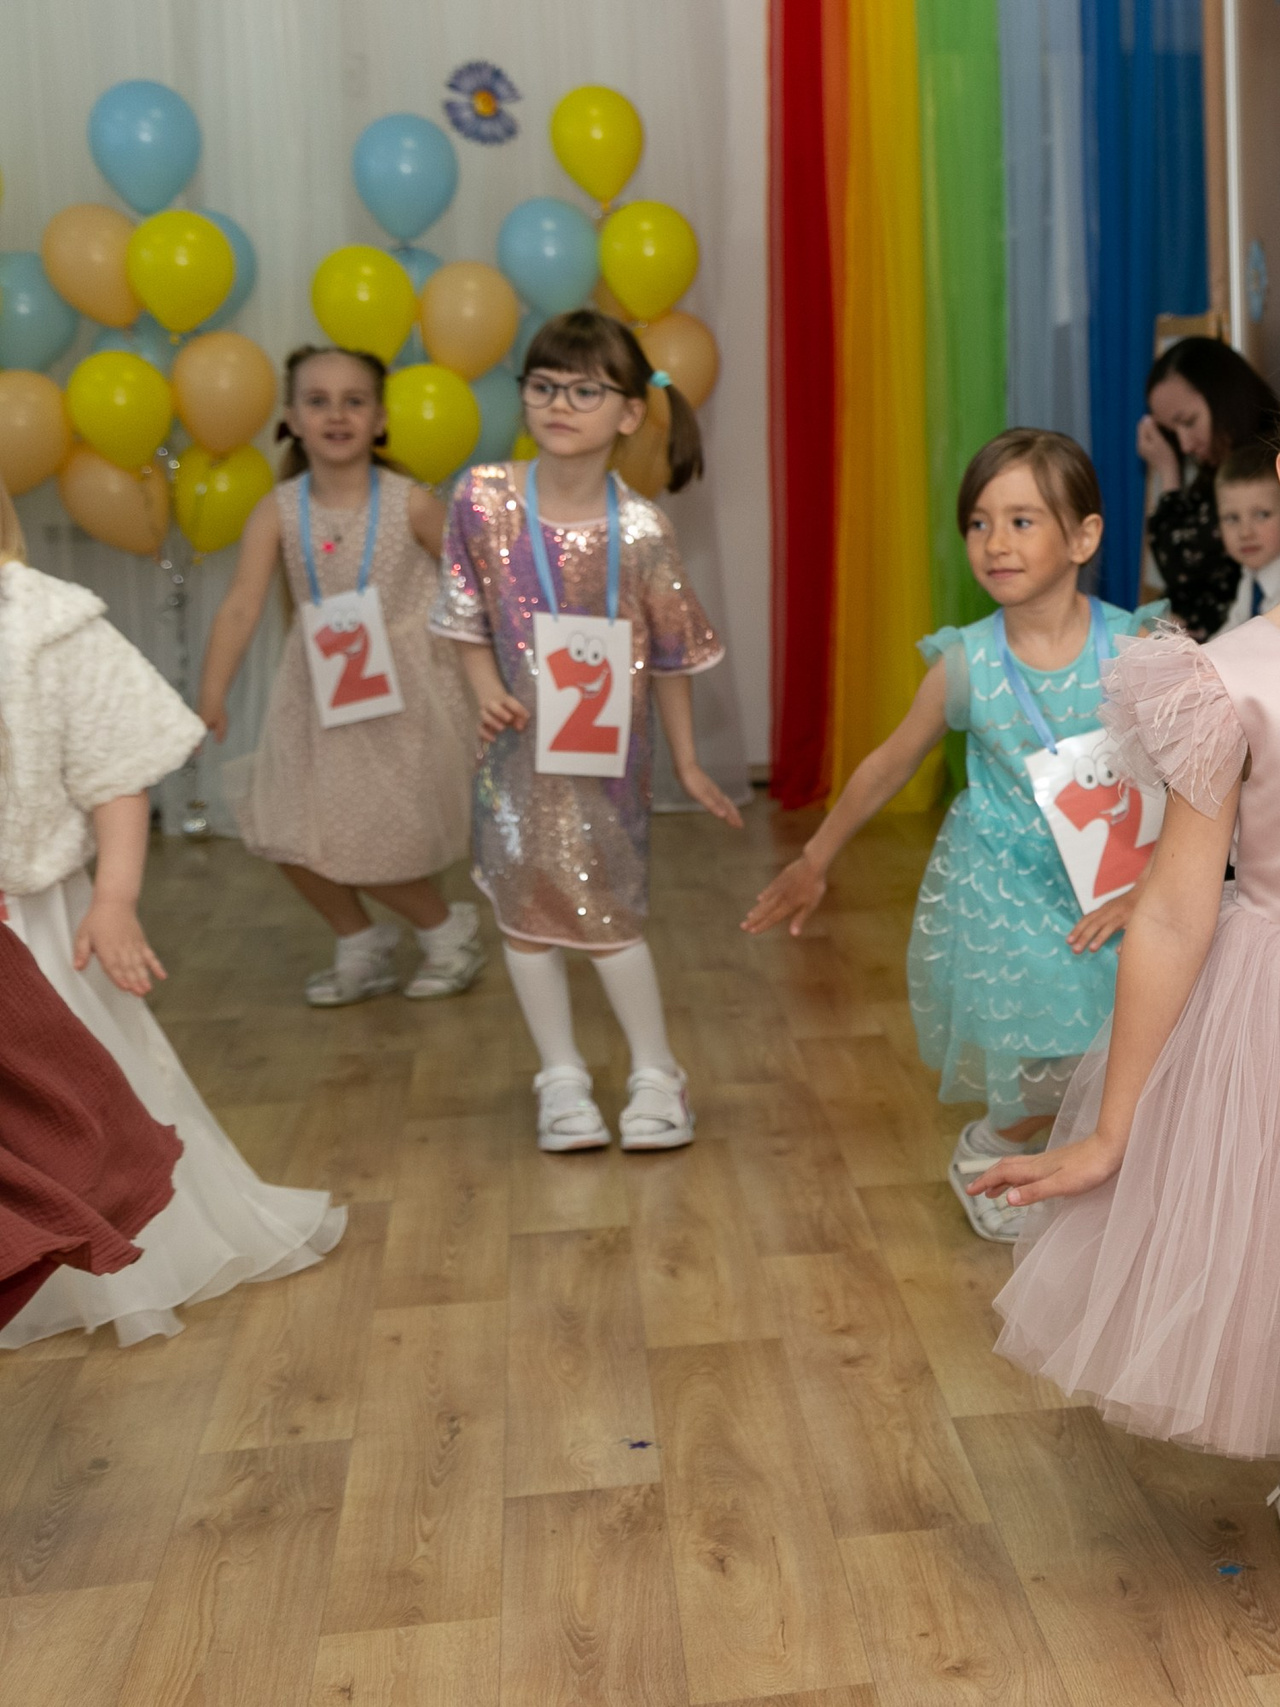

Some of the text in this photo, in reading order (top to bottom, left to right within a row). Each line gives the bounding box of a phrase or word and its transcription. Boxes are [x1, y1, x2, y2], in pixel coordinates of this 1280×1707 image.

[313, 616, 391, 709] 2
[546, 643, 620, 754] 2
[1054, 765, 1160, 900] 2
